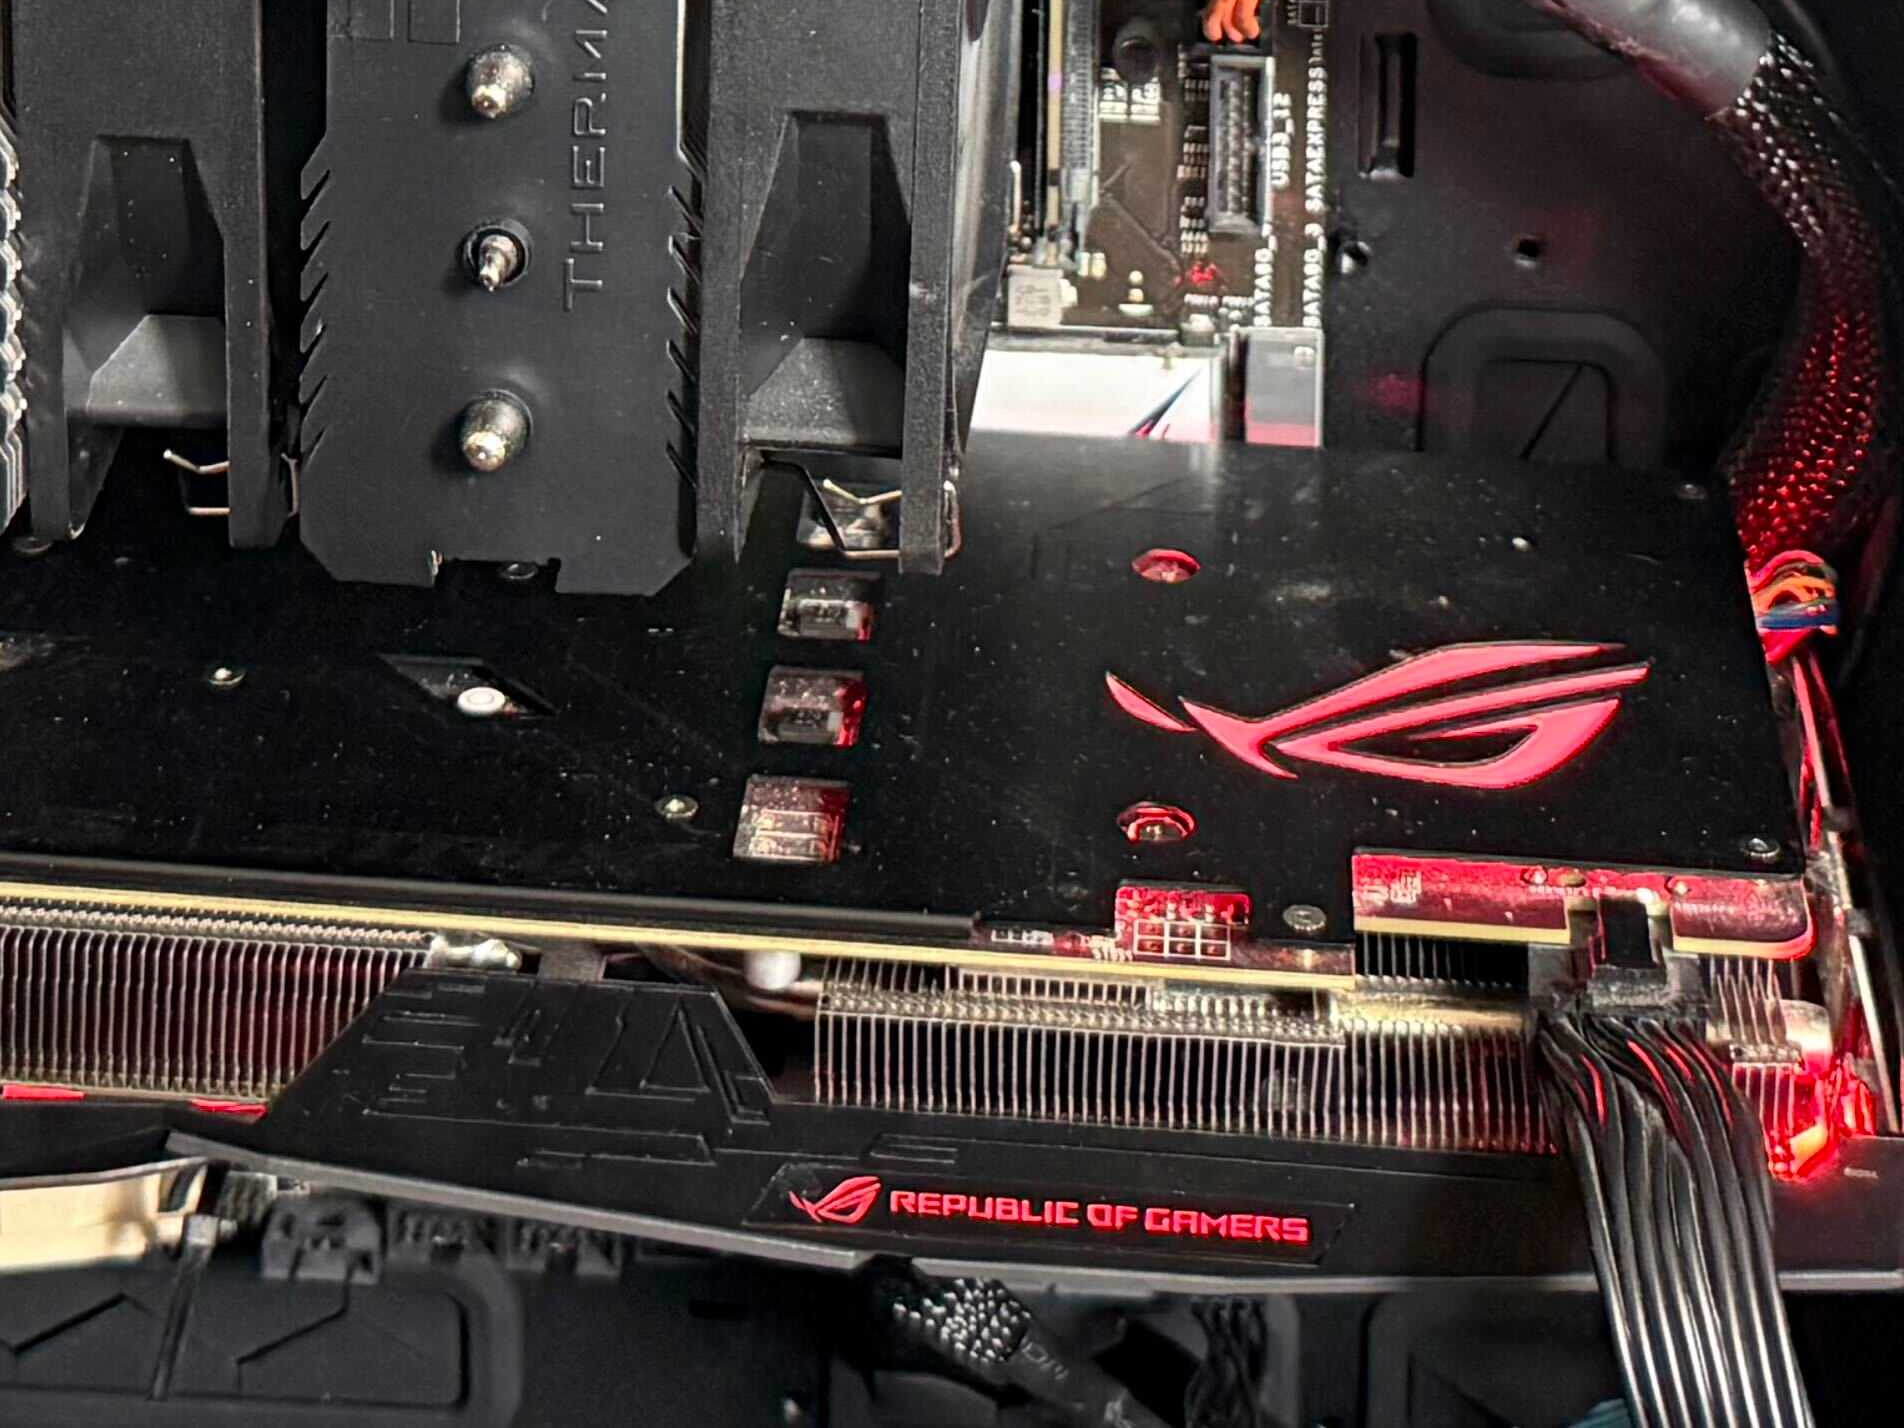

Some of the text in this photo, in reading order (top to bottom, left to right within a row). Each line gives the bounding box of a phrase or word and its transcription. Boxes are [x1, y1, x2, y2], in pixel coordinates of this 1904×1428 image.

[890, 1190, 1310, 1245] REPUBLIC OF GAMERS
